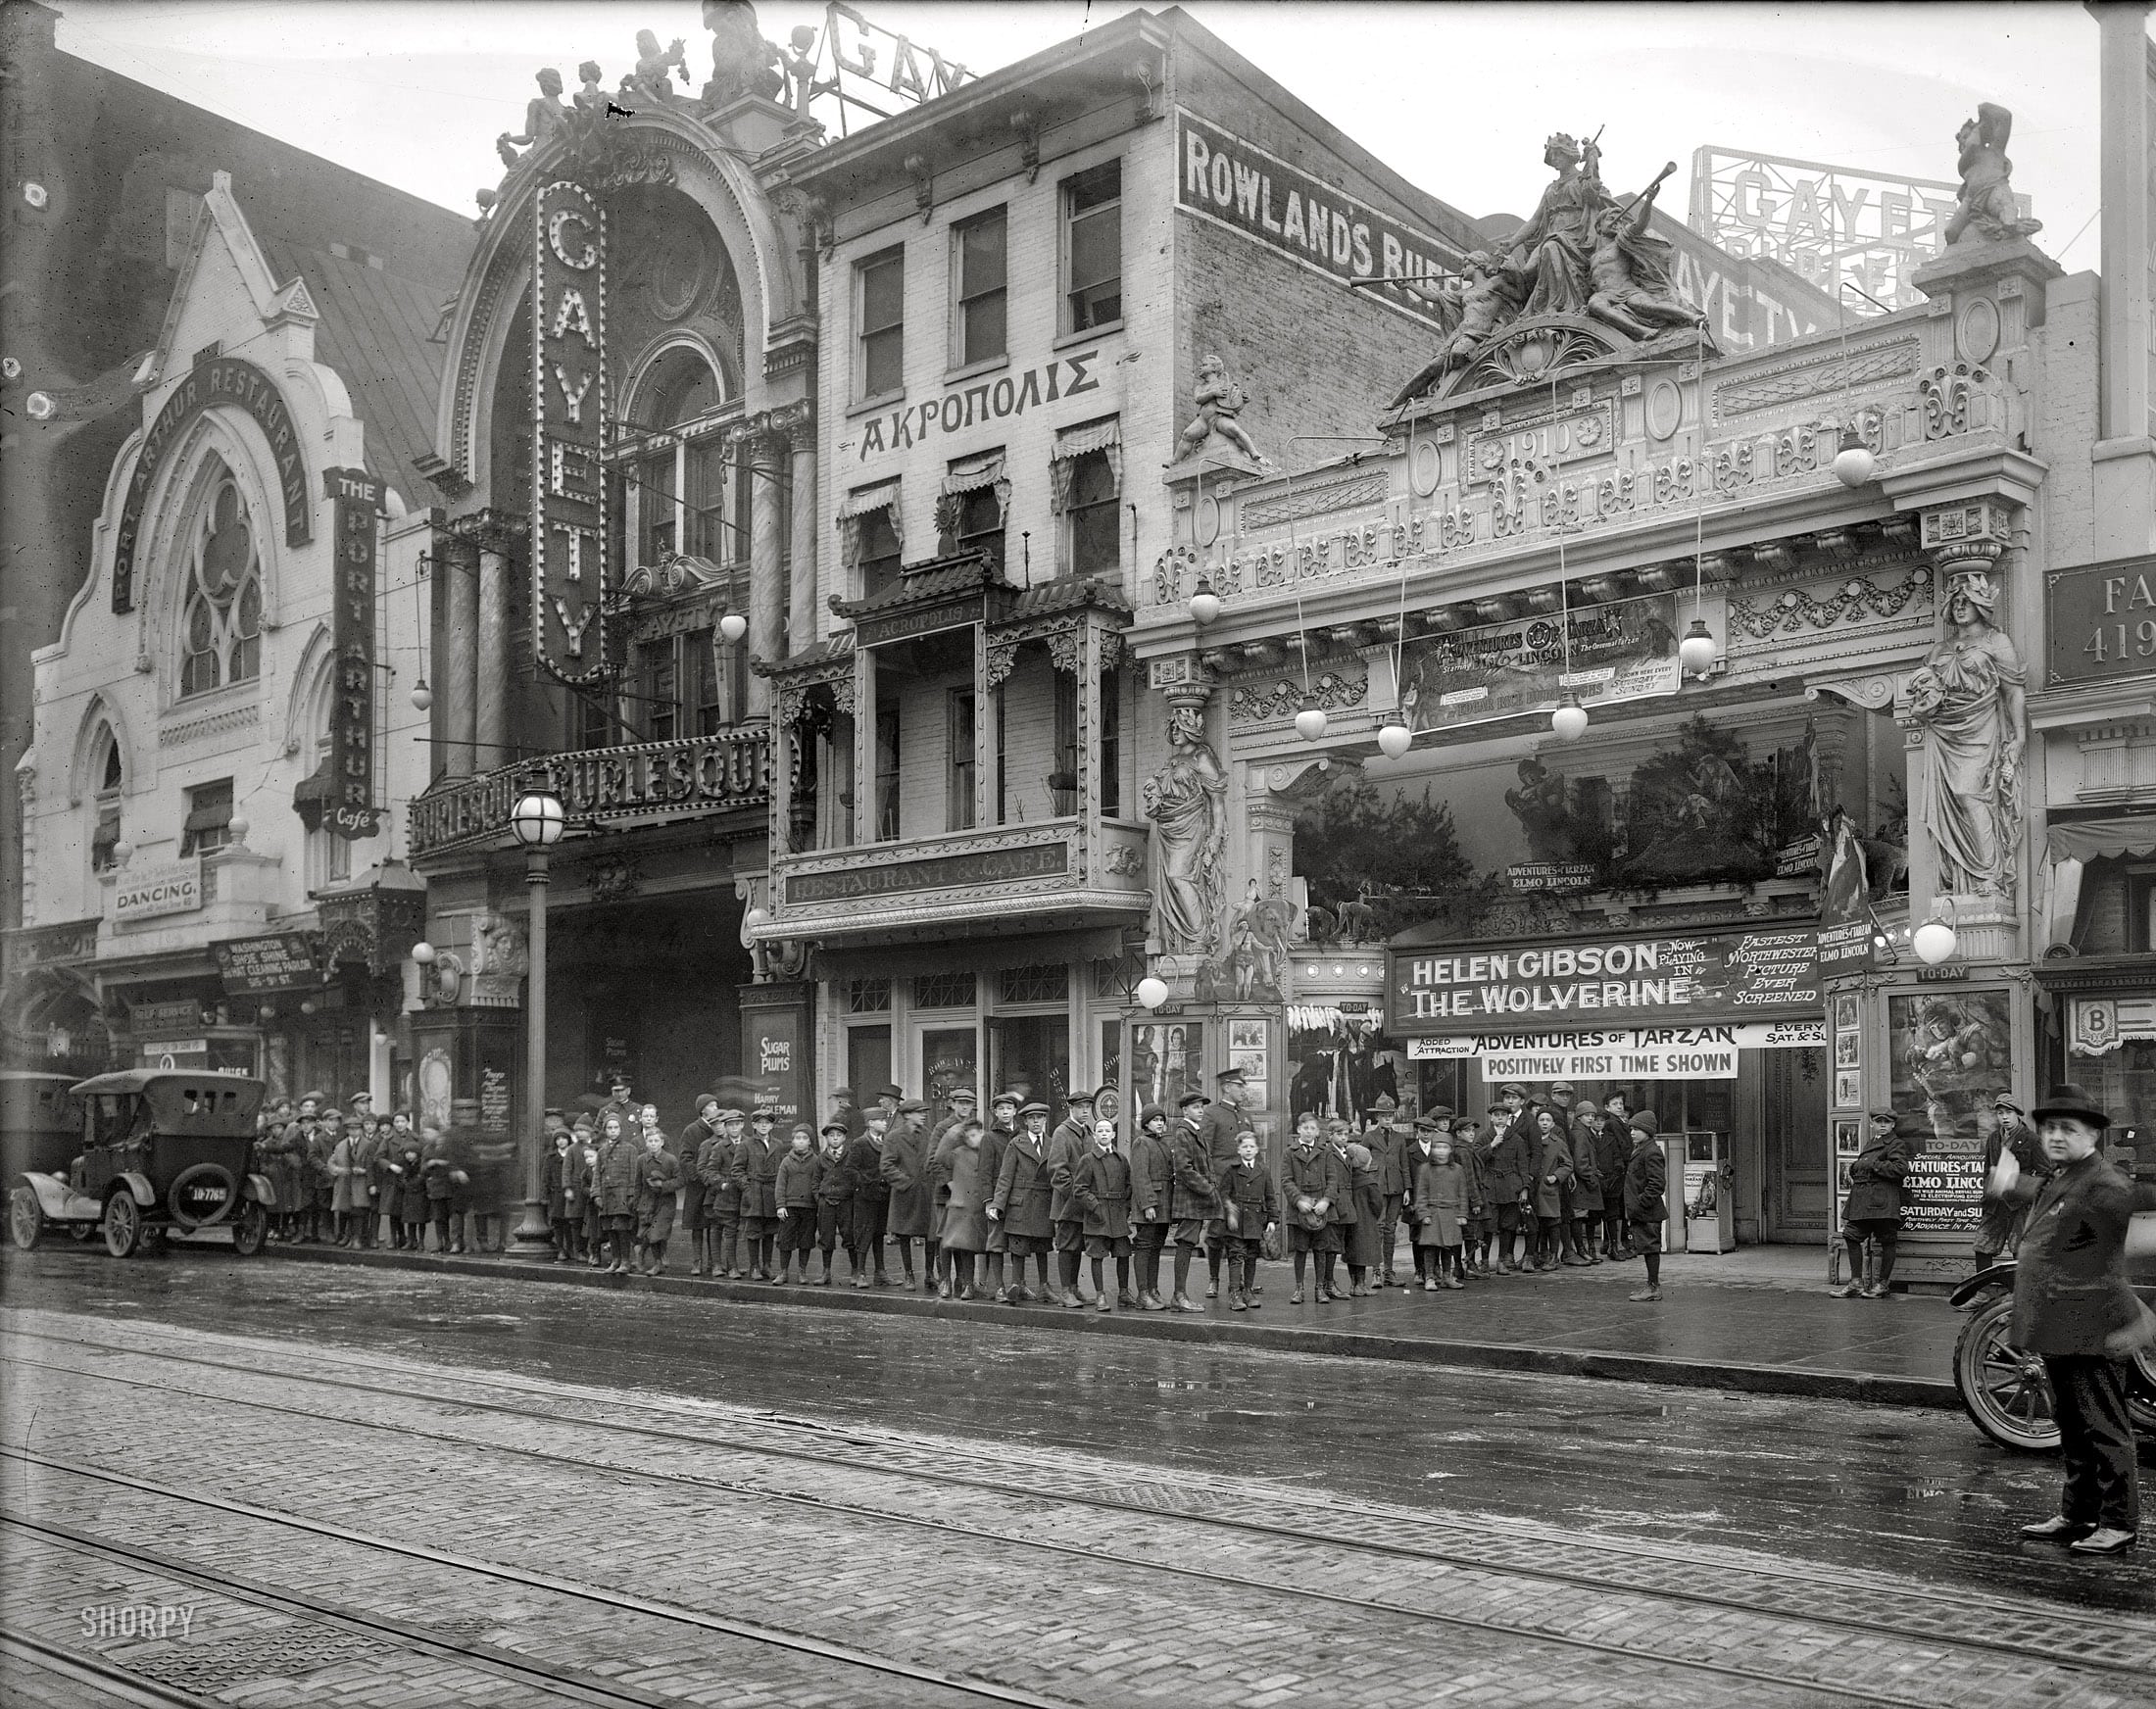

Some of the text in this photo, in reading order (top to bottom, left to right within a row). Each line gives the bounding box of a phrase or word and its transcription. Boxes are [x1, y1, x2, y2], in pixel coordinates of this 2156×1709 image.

[1187, 129, 1372, 276] ROWLAND'S
[1735, 170, 1957, 253] GAYET
[1676, 250, 1817, 345] AYETY
[548, 208, 600, 659] GAYETY
[1509, 423, 1570, 459] 1910
[115, 367, 304, 600] PORT ARTHUR RESTAURANT
[879, 606, 963, 638] ACROPOLIS
[337, 477, 376, 829] THE PORT ARTHUR Café
[1581, 644, 1592, 653] The
[1619, 669, 1641, 679] SHOWN
[793, 862, 948, 899] RESTAURANT
[956, 859, 977, 879] &
[1507, 865, 1557, 877] ADVENTURES
[1512, 875, 1592, 888] ELMO LINCOLN
[229, 940, 283, 953] WASHINGTON
[1669, 941, 1695, 952] NOW
[1741, 933, 1808, 950] FASTEST
[231, 949, 290, 966] SHOE SHINE
[1659, 951, 1705, 966] PLAYING
[1725, 946, 1817, 967] NORTHWESTER
[1820, 943, 1869, 962] ELMO LINCOLN
[1413, 943, 1658, 985] HELEN GIBSON
[1674, 965, 1692, 976] IN
[1744, 961, 1811, 978] PICTURE
[1751, 977, 1797, 990] EVER
[1734, 990, 1816, 1005] SCREENED
[1775, 1022, 1824, 1032] EVERY
[2089, 1009, 2106, 1031] B
[1420, 1038, 1451, 1047] ADDED
[1609, 1033, 1626, 1043] OF
[1765, 1032, 1795, 1044] SAT.
[1797, 1032, 1811, 1041] &
[760, 1037, 790, 1057] SUGAR
[1414, 1046, 1470, 1056] ATTRACTION
[761, 1057, 790, 1075] PLUMS
[1489, 1053, 1732, 1076] POSITIVELY FIRST TIME SHOWN
[755, 1093, 779, 1104] HARRY
[1928, 1141, 1980, 1150] TO-DAY
[1902, 1176, 1941, 1189] ELMO
[1900, 1206, 1954, 1216] SATURDAY
[1954, 1208, 1967, 1217] and
